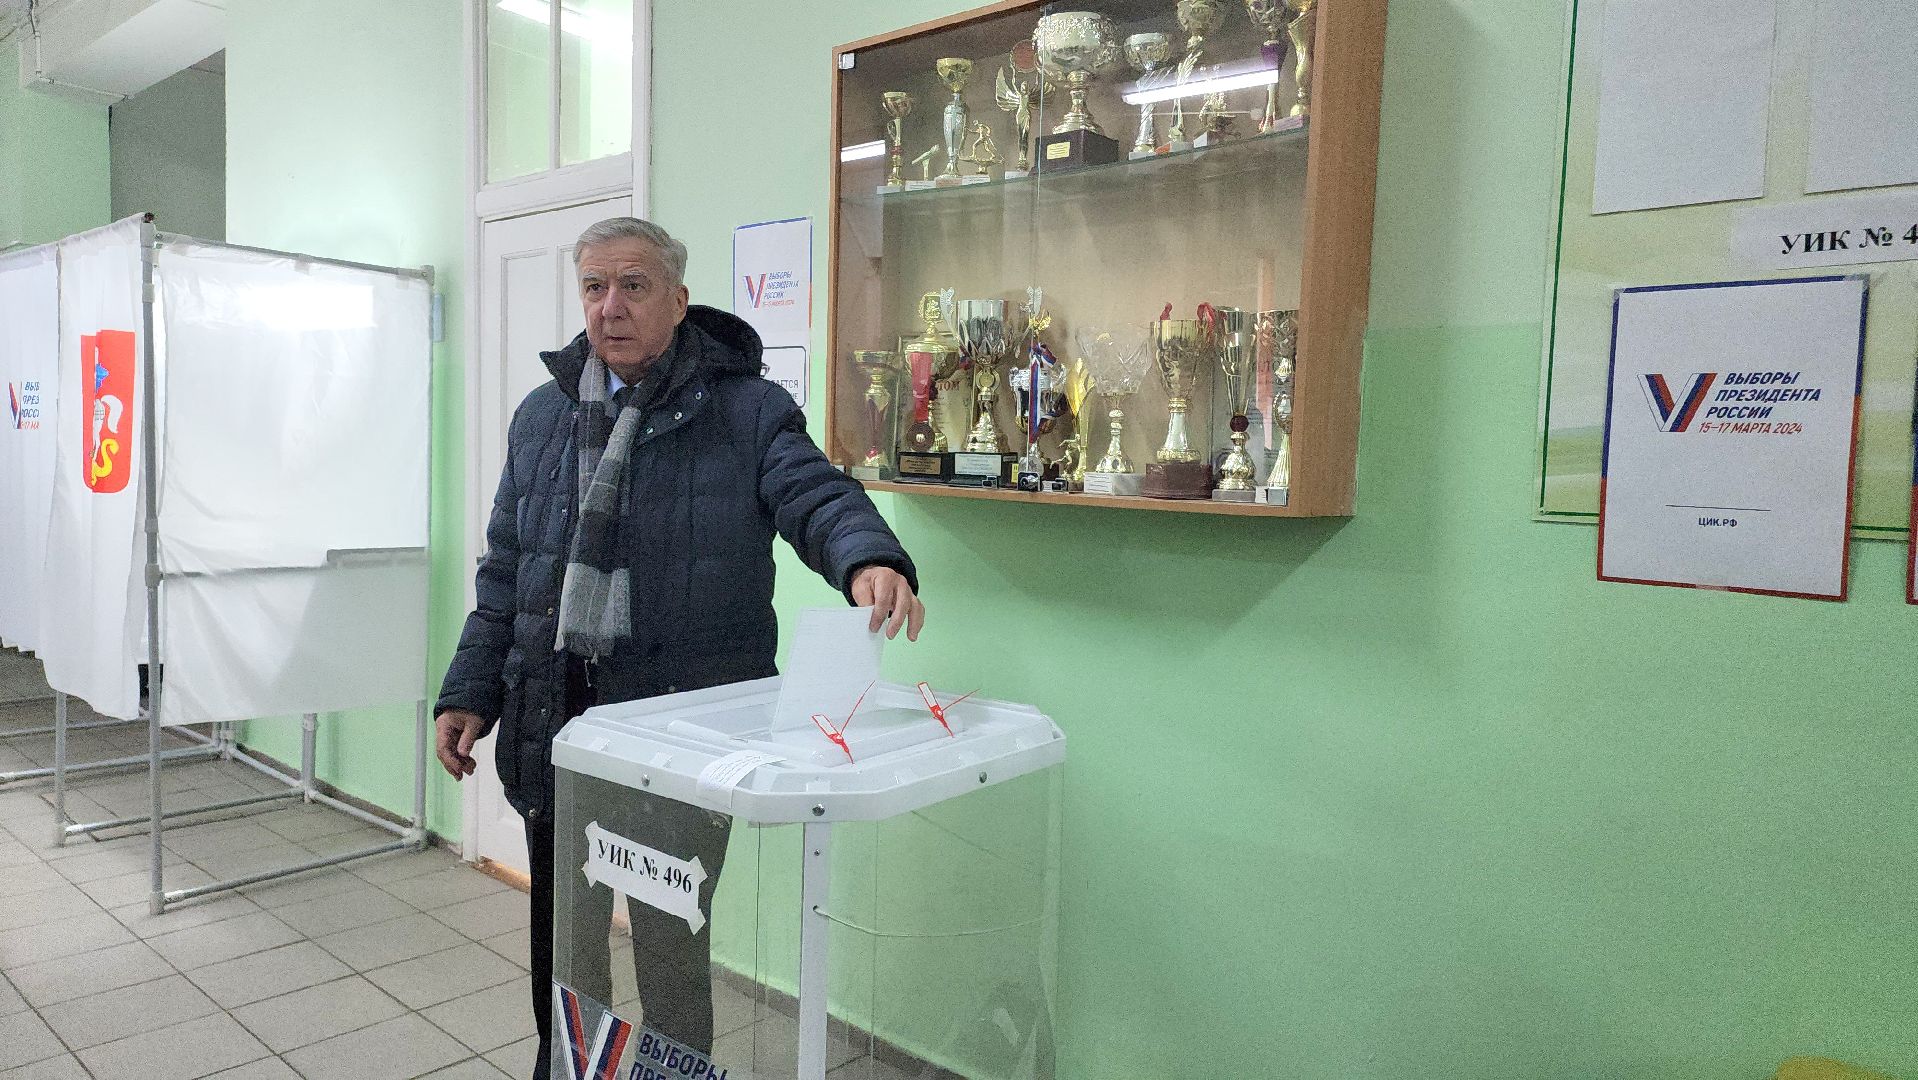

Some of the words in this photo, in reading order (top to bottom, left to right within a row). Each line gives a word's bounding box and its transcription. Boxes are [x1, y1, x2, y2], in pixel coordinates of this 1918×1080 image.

[1779, 229, 1850, 255] УИК
[1858, 226, 1893, 249] №
[1902, 223, 1918, 245] 4
[1724, 371, 1801, 386] ВЫБОРЫ
[1714, 388, 1822, 403] ПРЕЗИДЕНТА
[1705, 406, 1773, 419] РОССИИ
[1731, 422, 1772, 434] МАРТА
[1772, 422, 1803, 434] 2024
[1698, 517, 1738, 528] ЦИК.РФ
[597, 838, 636, 873] УИК
[639, 855, 659, 881] №
[663, 866, 693, 893] 496
